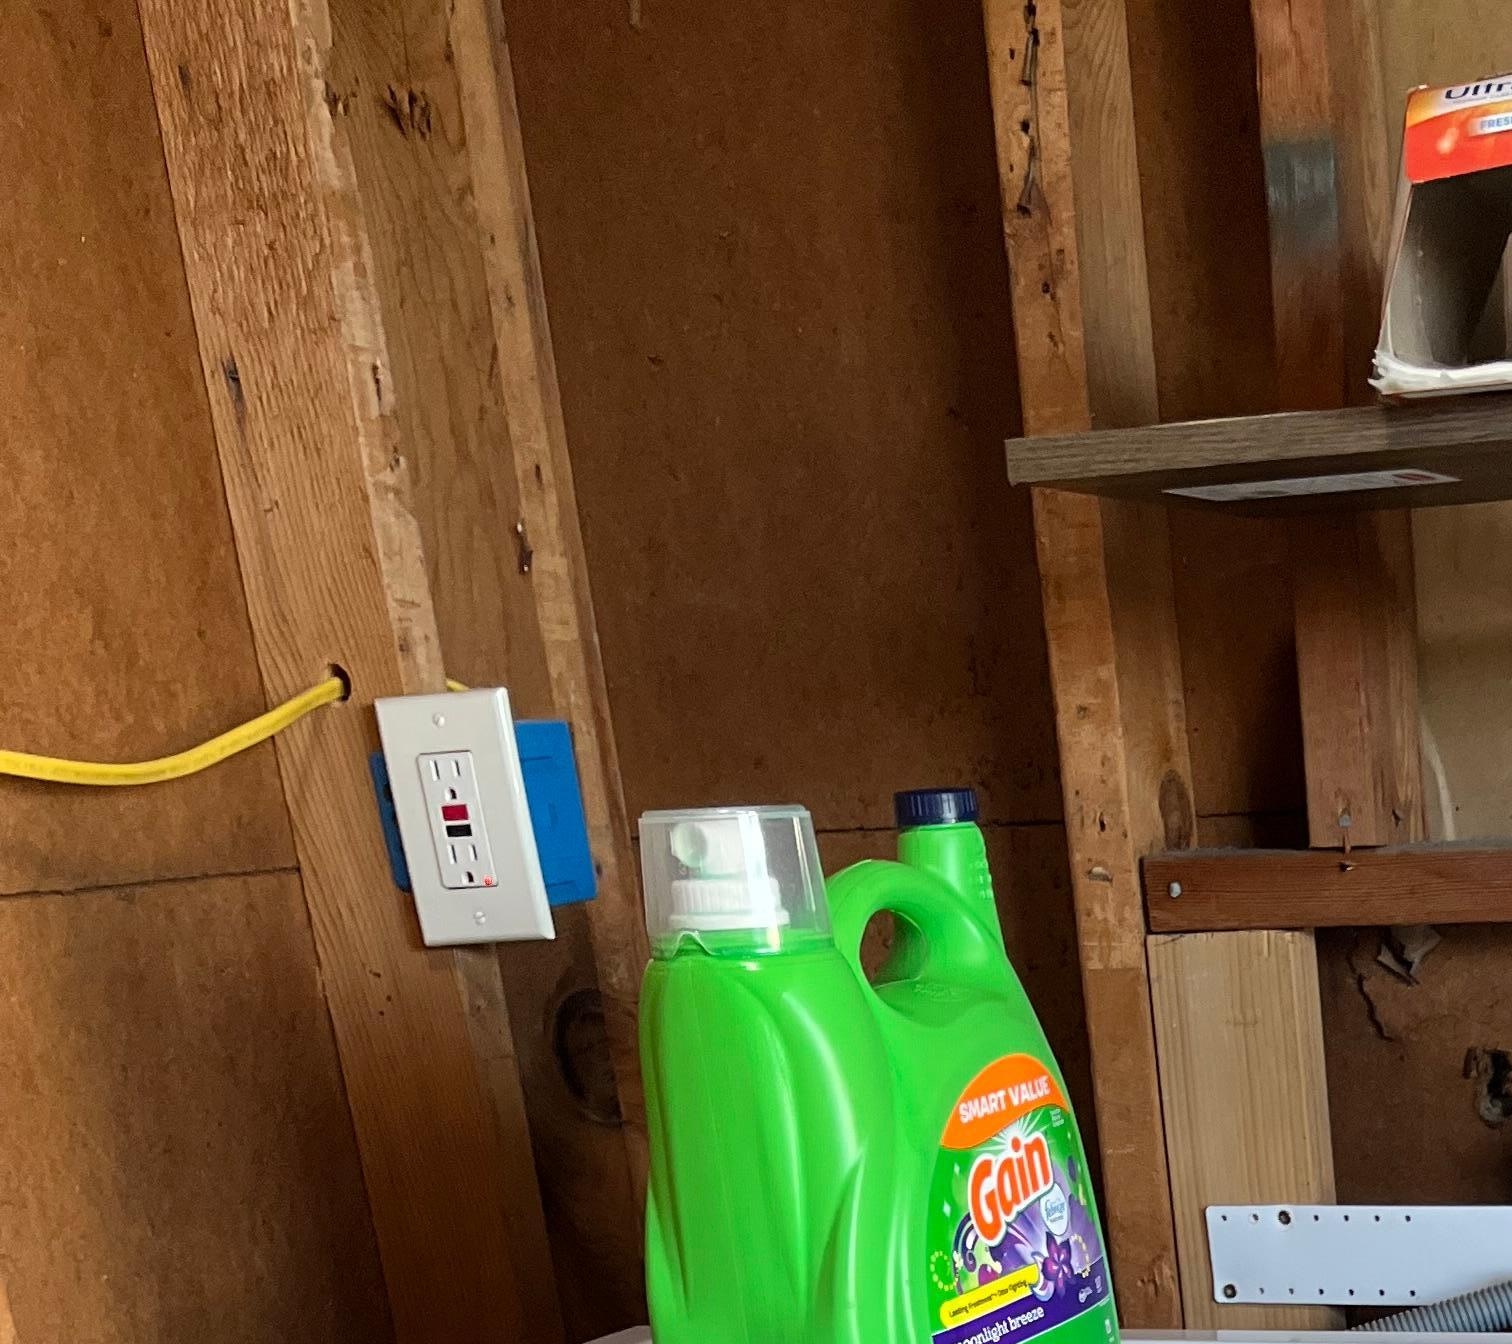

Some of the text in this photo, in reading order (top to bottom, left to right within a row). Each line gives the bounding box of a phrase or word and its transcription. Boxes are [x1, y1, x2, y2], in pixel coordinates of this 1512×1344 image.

[958, 1075, 1051, 1124] SMART VALUE
[971, 1135, 1051, 1241] Gain
[1007, 1306, 1045, 1334] breeze
